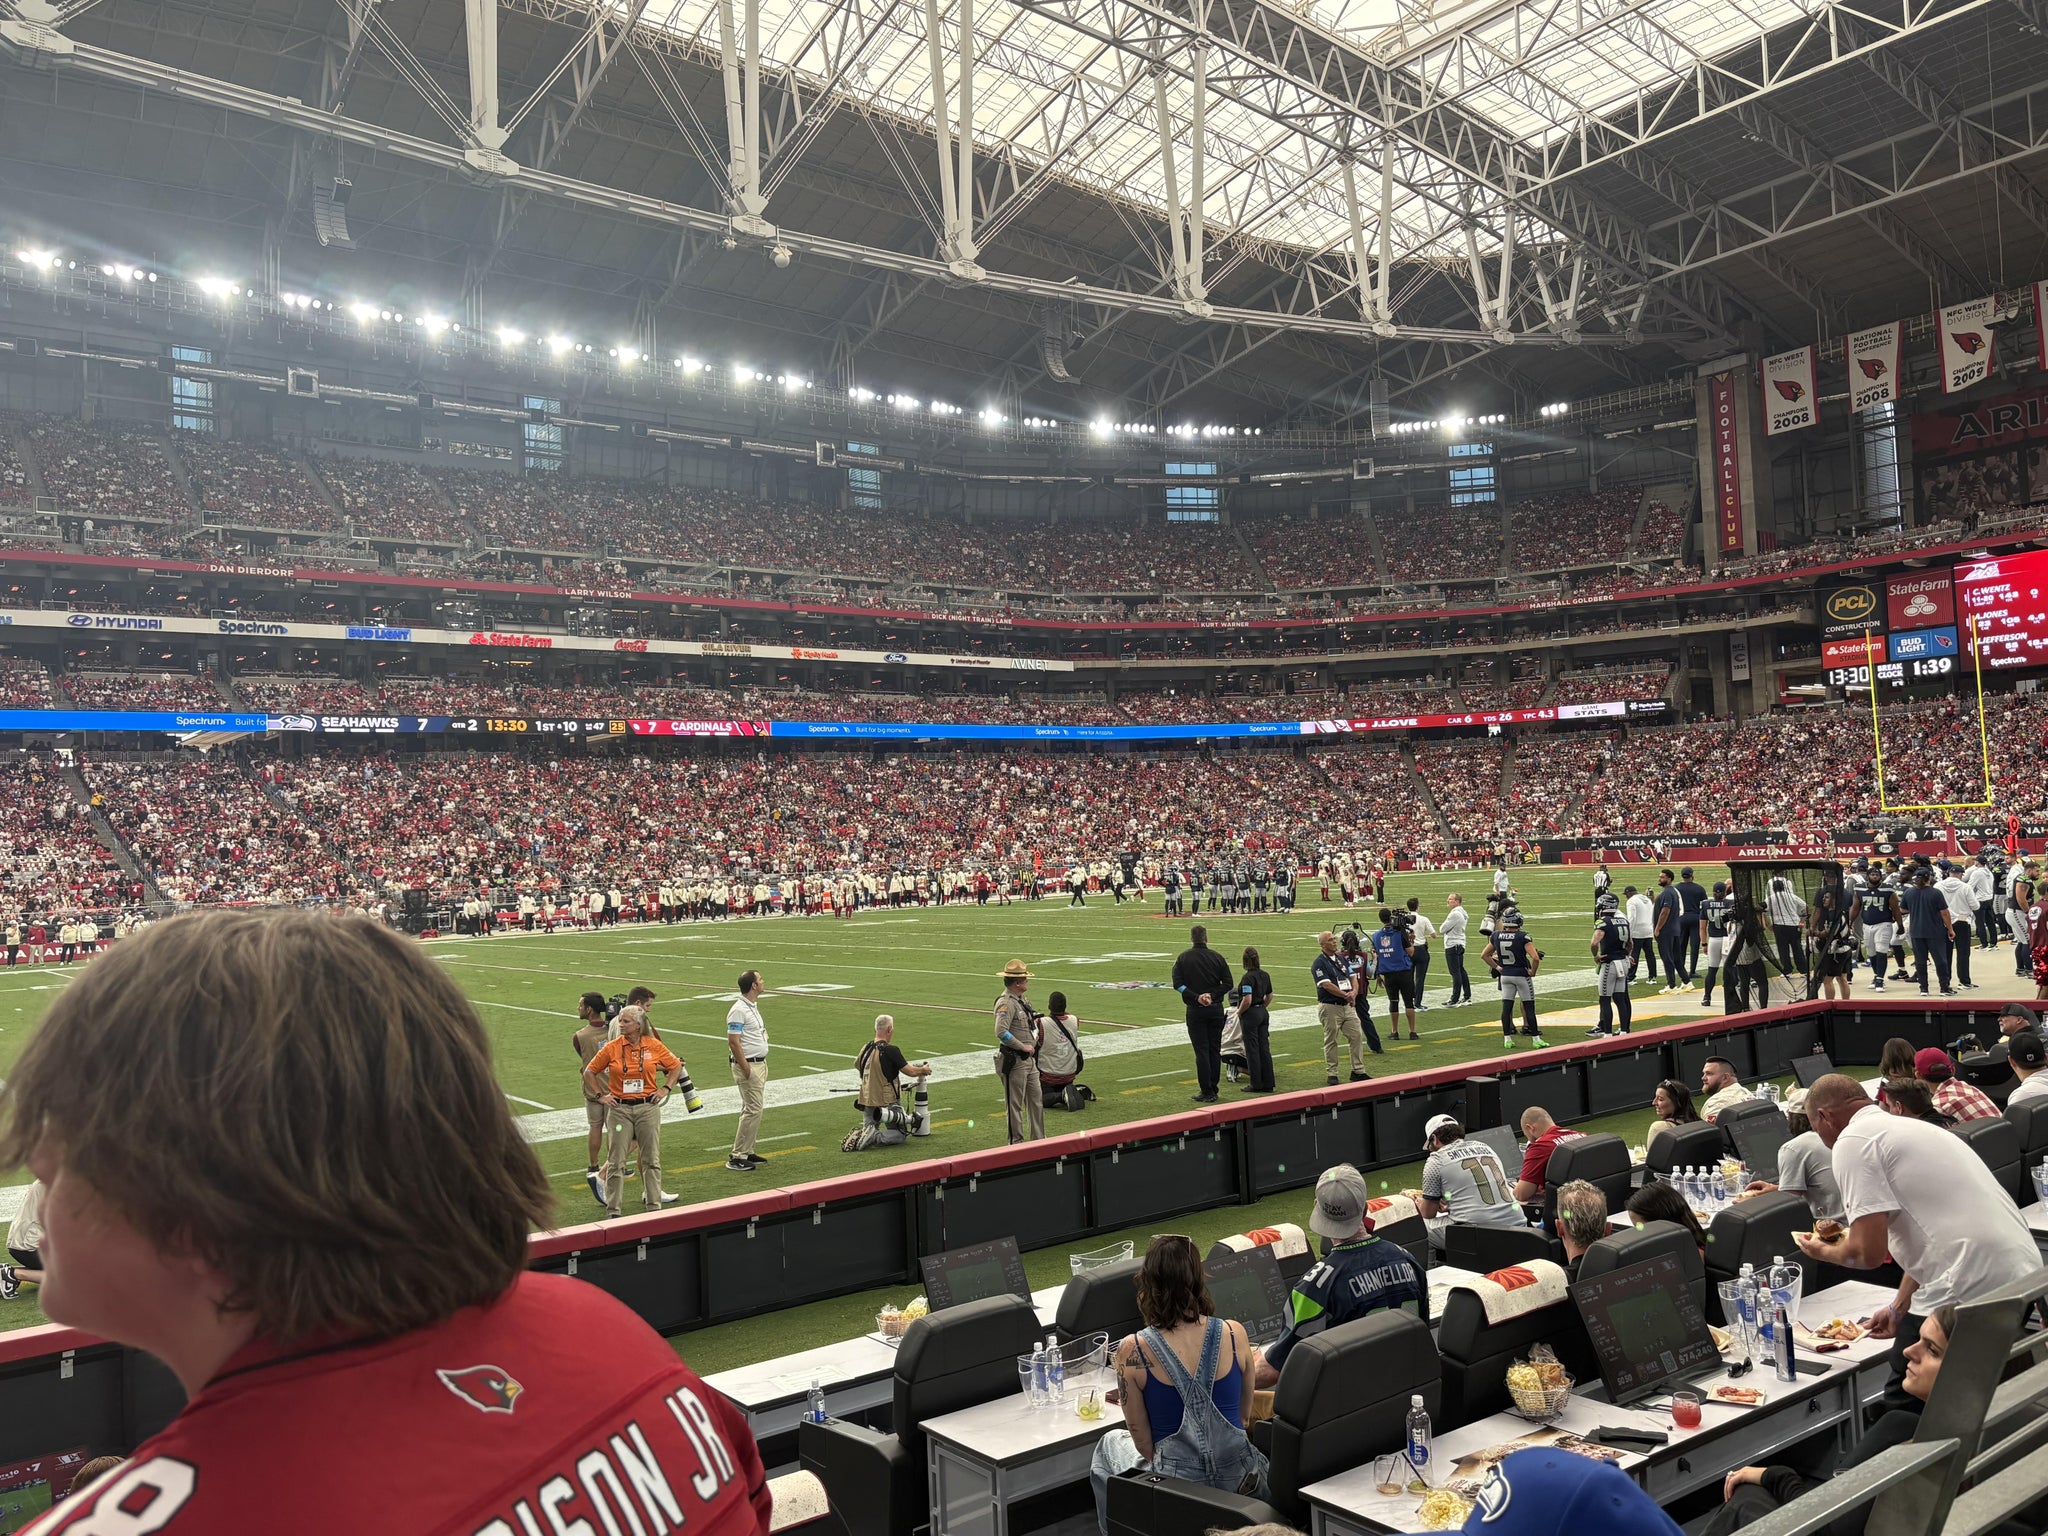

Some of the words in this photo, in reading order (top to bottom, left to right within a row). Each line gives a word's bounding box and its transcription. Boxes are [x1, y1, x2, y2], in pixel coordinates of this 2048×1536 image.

[1946, 308, 1963, 318] NFC
[1964, 302, 1988, 312] WEST
[1946, 309, 1989, 326] DIVISION
[1853, 327, 1893, 343] NATIONAL
[1853, 334, 1893, 349] FOOTBALL
[1853, 340, 1892, 355] CONFERENCE
[1768, 356, 1783, 366] NFC
[1783, 351, 1804, 362] WEST
[1769, 359, 1806, 373] DIVISION
[1952, 360, 1985, 376] CHAMPIONS
[1953, 367, 1984, 387] 2009
[1856, 381, 1889, 397] CHAMPIONS
[1856, 388, 1890, 408] 2008
[1773, 406, 1809, 419] CHAMPIONS
[1773, 412, 1810, 430] 2008
[1952, 396, 2048, 444] ARI
[1719, 391, 1733, 492] FOOTBALL
[1726, 496, 1736, 545] CLUB
[210, 564, 234, 573] DAN
[237, 566, 294, 577] DIERDORF
[565, 589, 595, 597] LARRY
[597, 591, 632, 599] WILSON
[1529, 600, 1571, 609] MARSHALL
[1572, 594, 1614, 605] GOLDBERG
[1834, 595, 1869, 612] PCL
[95, 616, 163, 630] HYUNDAI
[218, 619, 284, 635] Spectrum
[995, 617, 1013, 625] LANE
[1825, 620, 1880, 633] CONSTRUCTION
[348, 627, 374, 638] BUD
[375, 629, 410, 640] LIGHT
[701, 643, 723, 651] GILA
[724, 644, 751, 653] RIVER
[1897, 643, 1926, 653] LIGHT
[1900, 637, 1922, 646] BUD
[1010, 658, 1050, 671] AVNET
[1877, 663, 1903, 672] BREAK
[1913, 657, 1952, 676] 1:39
[1990, 657, 2025, 667] Spectrum
[1829, 666, 1870, 685] 13:30
[1877, 669, 1904, 678] CLOCK
[1464, 715, 1473, 724] 6
[1499, 713, 1513, 722] 26
[1538, 710, 1554, 719] 4.3
[1574, 709, 1608, 717] STATS
[176, 716, 221, 727] Spectrum
[235, 718, 254, 726] Built
[322, 716, 399, 728] SEAHAWKS
[417, 718, 428, 731] 7
[467, 719, 478, 731] 2
[486, 719, 528, 732] 13:30
[562, 720, 578, 732] 10
[593, 722, 605, 731] 47
[611, 722, 624, 731] 25
[648, 722, 657, 733] 7
[671, 721, 732, 732] CARDINALS
[1371, 718, 1418, 728] J.LOVE
[808, 725, 837, 733] Spectrum
[1035, 728, 1058, 737] Spectrum
[1249, 725, 1275, 733] Spectrum
[1608, 839, 1646, 847] ARIZONA
[1649, 838, 1698, 846] CARINALS
[1738, 847, 1793, 857] ARIZNA
[1798, 845, 1872, 855] CARINALS
[1861, 895, 1885, 911] 74
[1617, 926, 1629, 949] 4
[1500, 941, 1516, 965] 5
[1461, 1156, 1514, 1205] 11
[1322, 1208, 1347, 1217] HUMAN
[1324, 1202, 1341, 1212] STAY
[1303, 1261, 1335, 1289] 31
[665, 1386, 735, 1501] JR
[1413, 1428, 1422, 1461] smart
